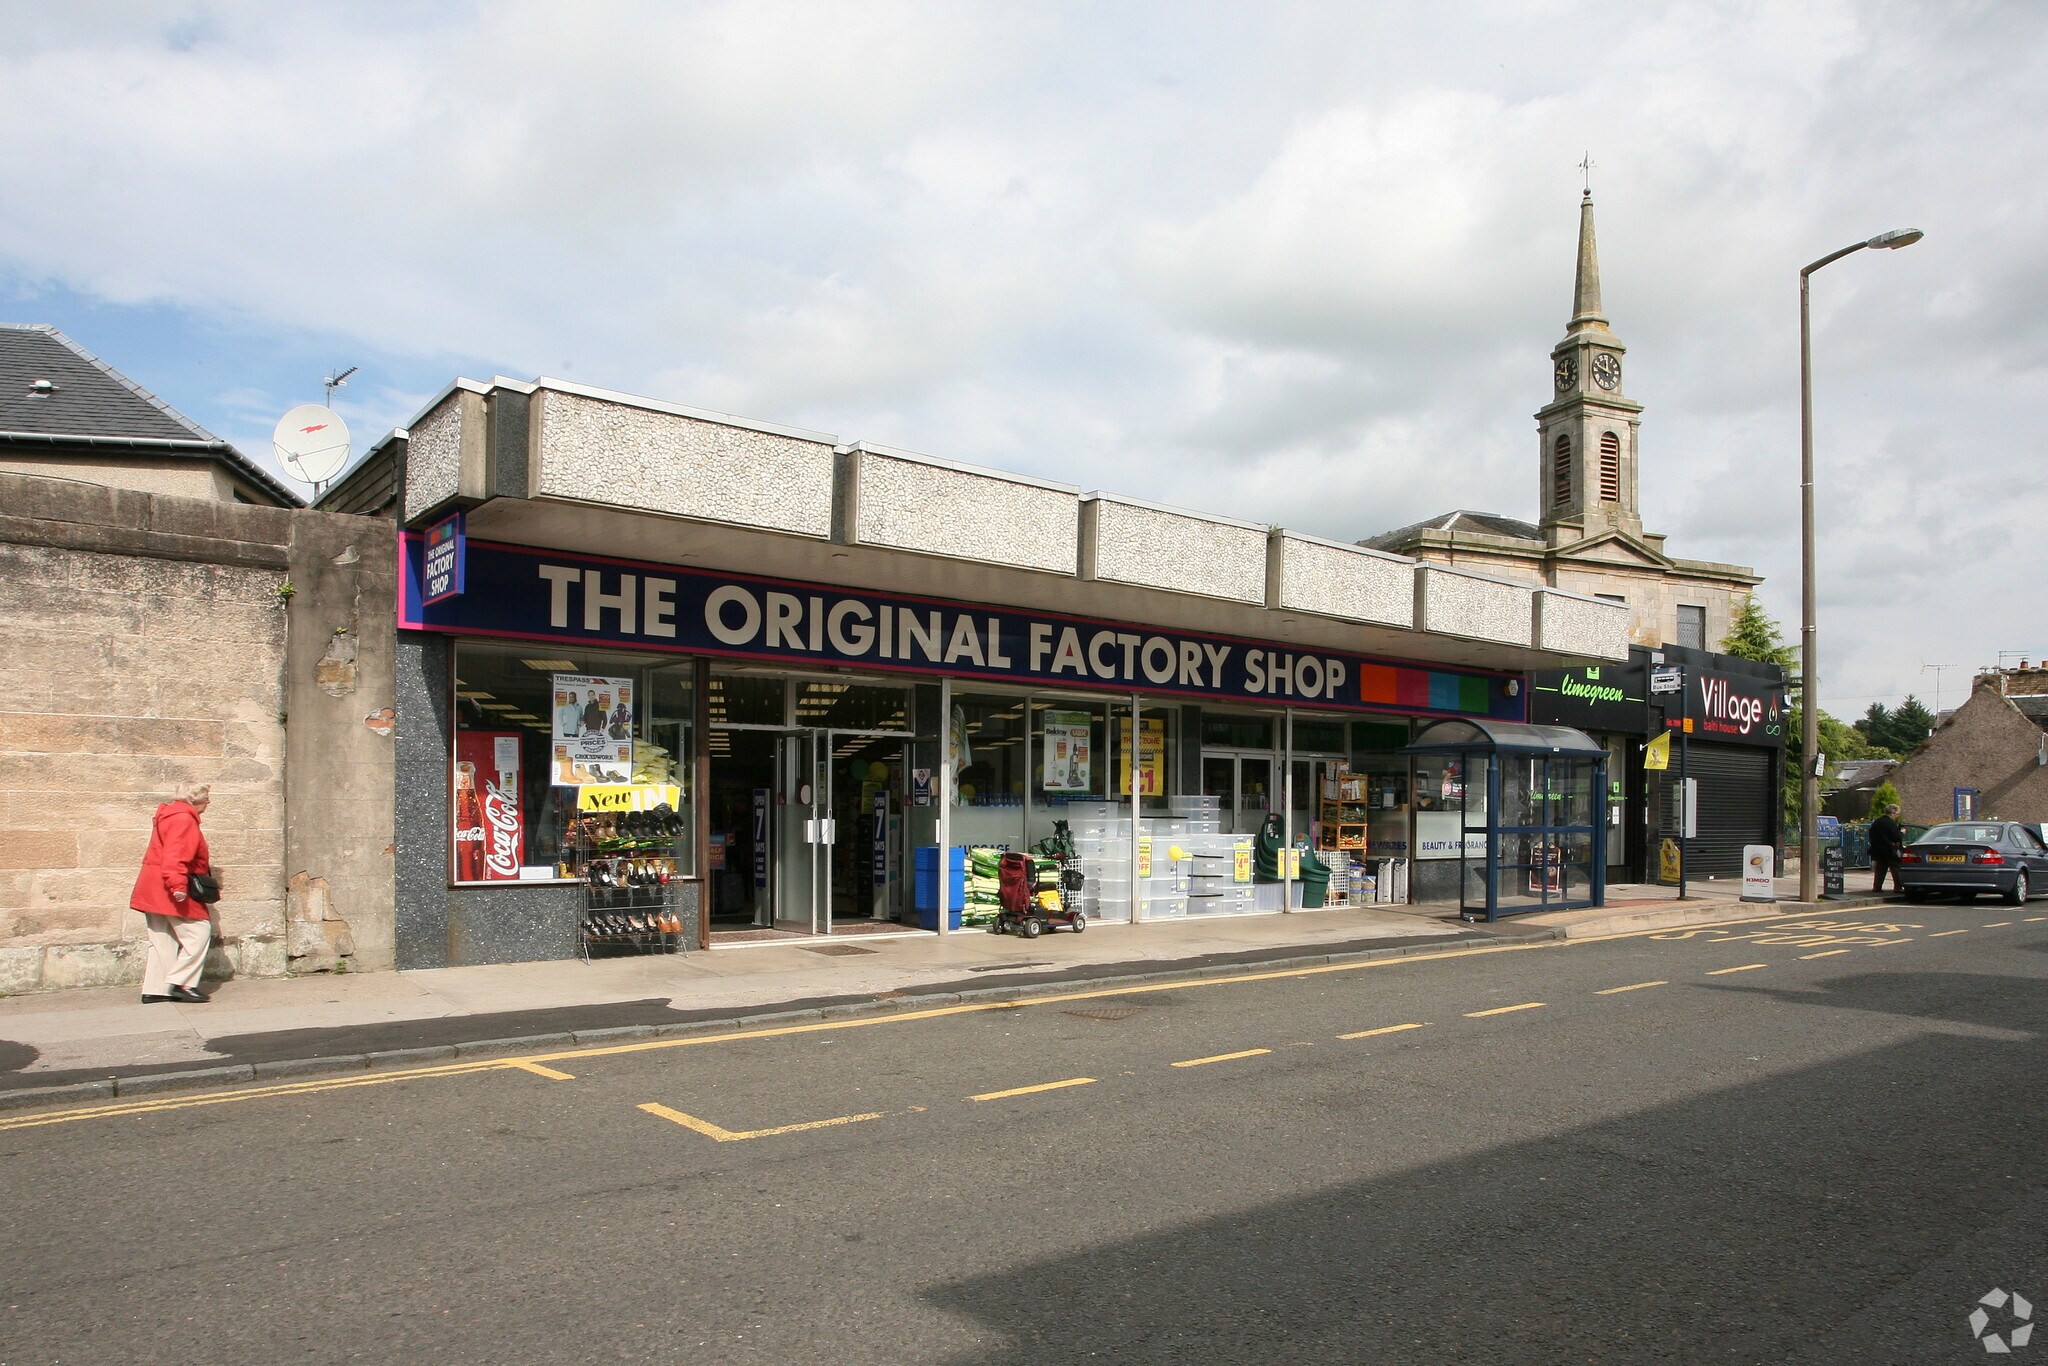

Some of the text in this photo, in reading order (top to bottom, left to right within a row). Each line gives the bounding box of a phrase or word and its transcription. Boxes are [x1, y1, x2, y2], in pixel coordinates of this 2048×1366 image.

[435, 539, 455, 557] ORIGINAL
[427, 552, 455, 579] FACTORY
[431, 574, 449, 596] SHOP
[539, 564, 1346, 699] THE ORIGINAL FACTORY SHOP
[1562, 674, 1624, 706] limegreen
[1700, 676, 1762, 734] Village
[1046, 727, 1068, 736] Beldray
[1703, 720, 1718, 731] balti
[1719, 722, 1738, 733] house
[586, 786, 666, 811] New IN
[486, 779, 518, 876] Coca-Col
[756, 808, 765, 840] 7
[875, 809, 884, 839] 7
[1422, 842, 1446, 850] BEAUTY
[1649, 930, 1915, 948] STOP
[1765, 920, 1924, 933] BUS
